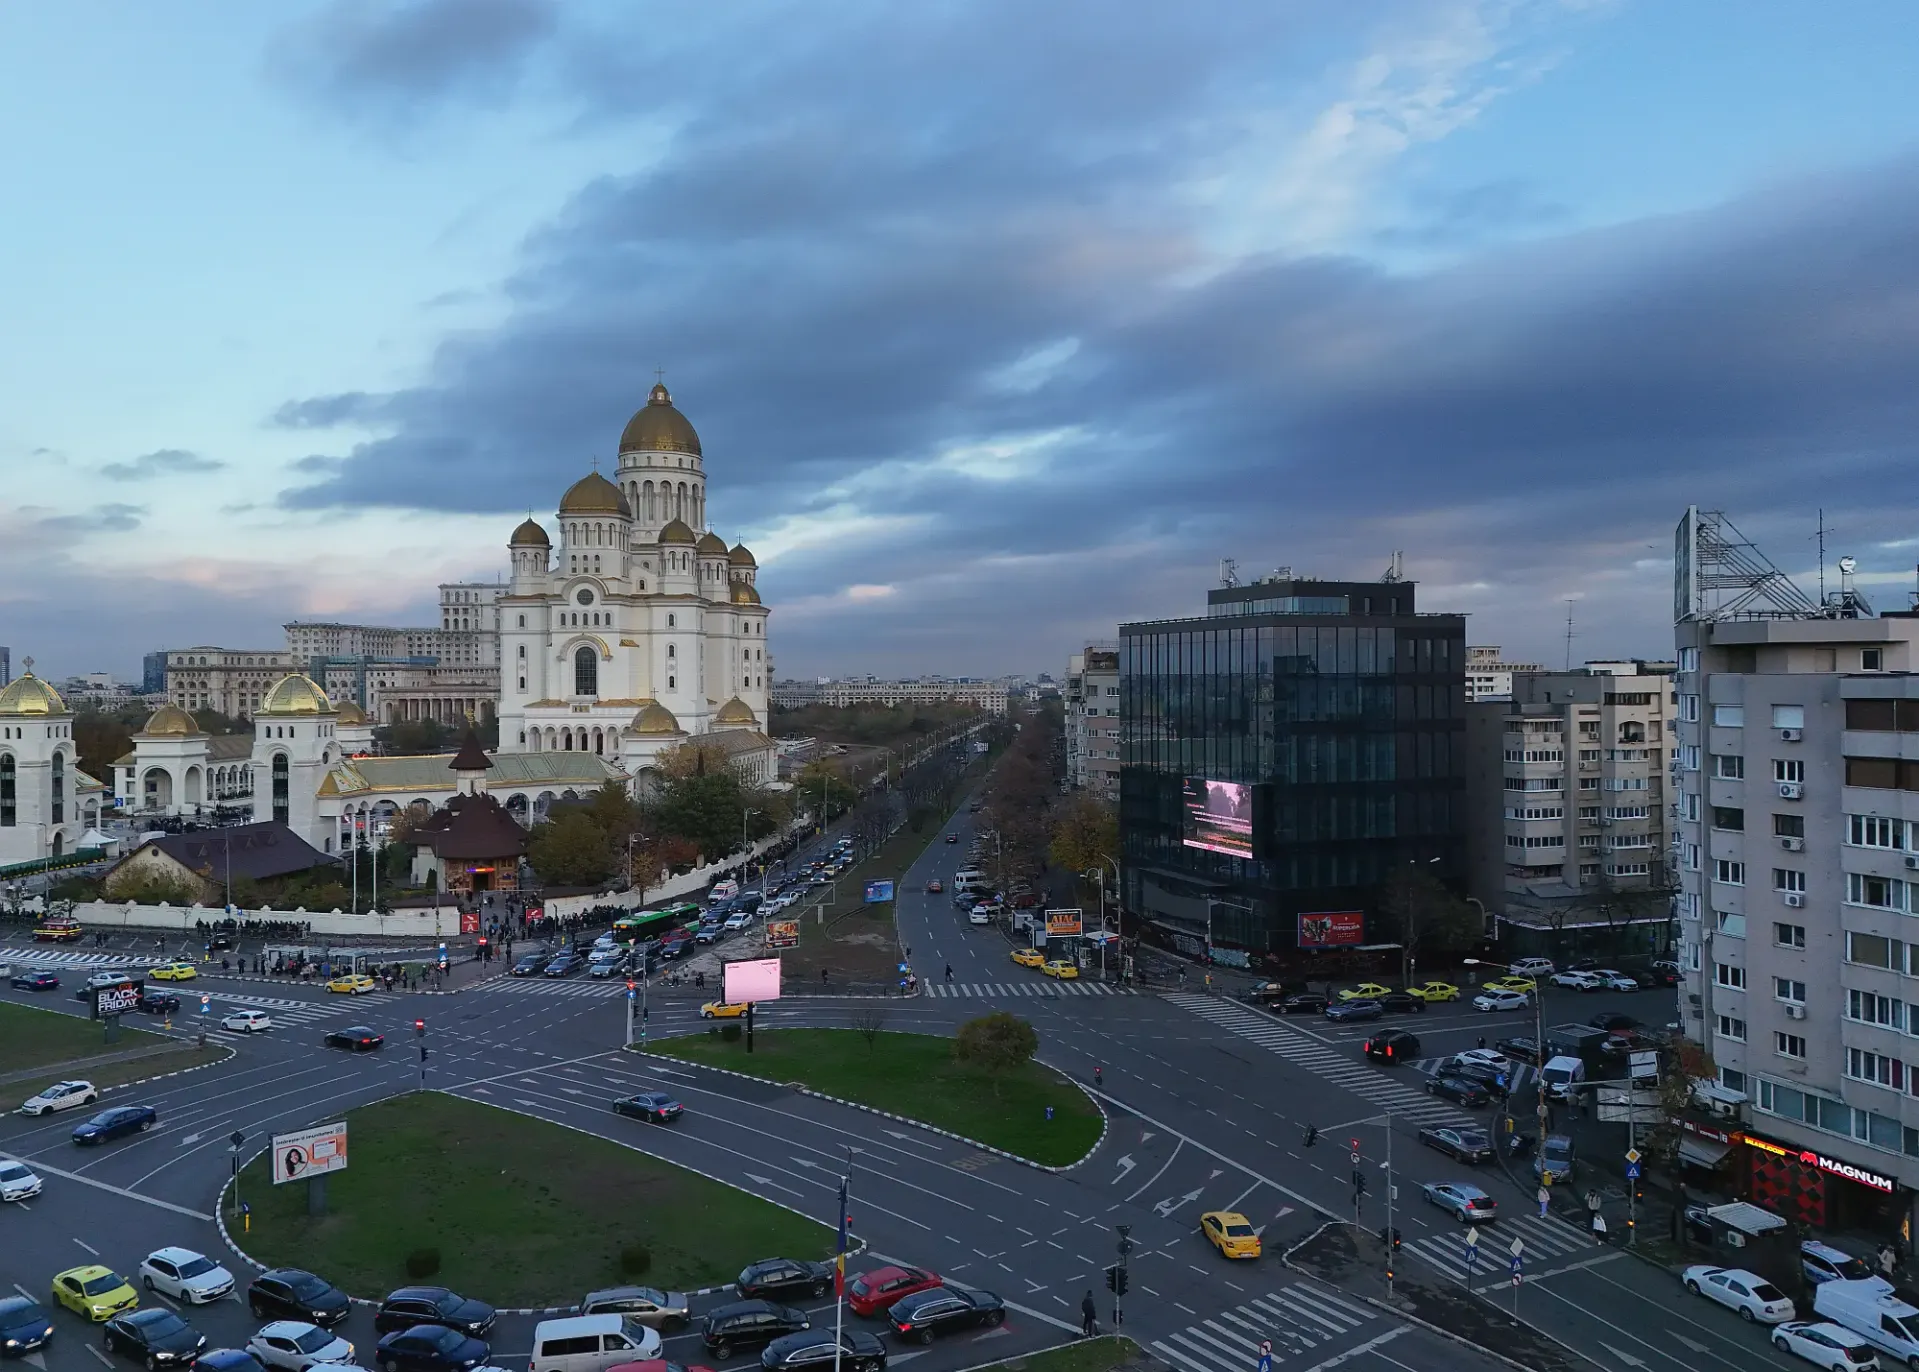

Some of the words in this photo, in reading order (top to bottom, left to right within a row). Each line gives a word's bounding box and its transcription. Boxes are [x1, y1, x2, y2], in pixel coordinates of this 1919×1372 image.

[98, 987, 139, 1003] BLACK
[98, 998, 138, 1012] FRIDAY
[1819, 1156, 1892, 1191] MAGNUM
